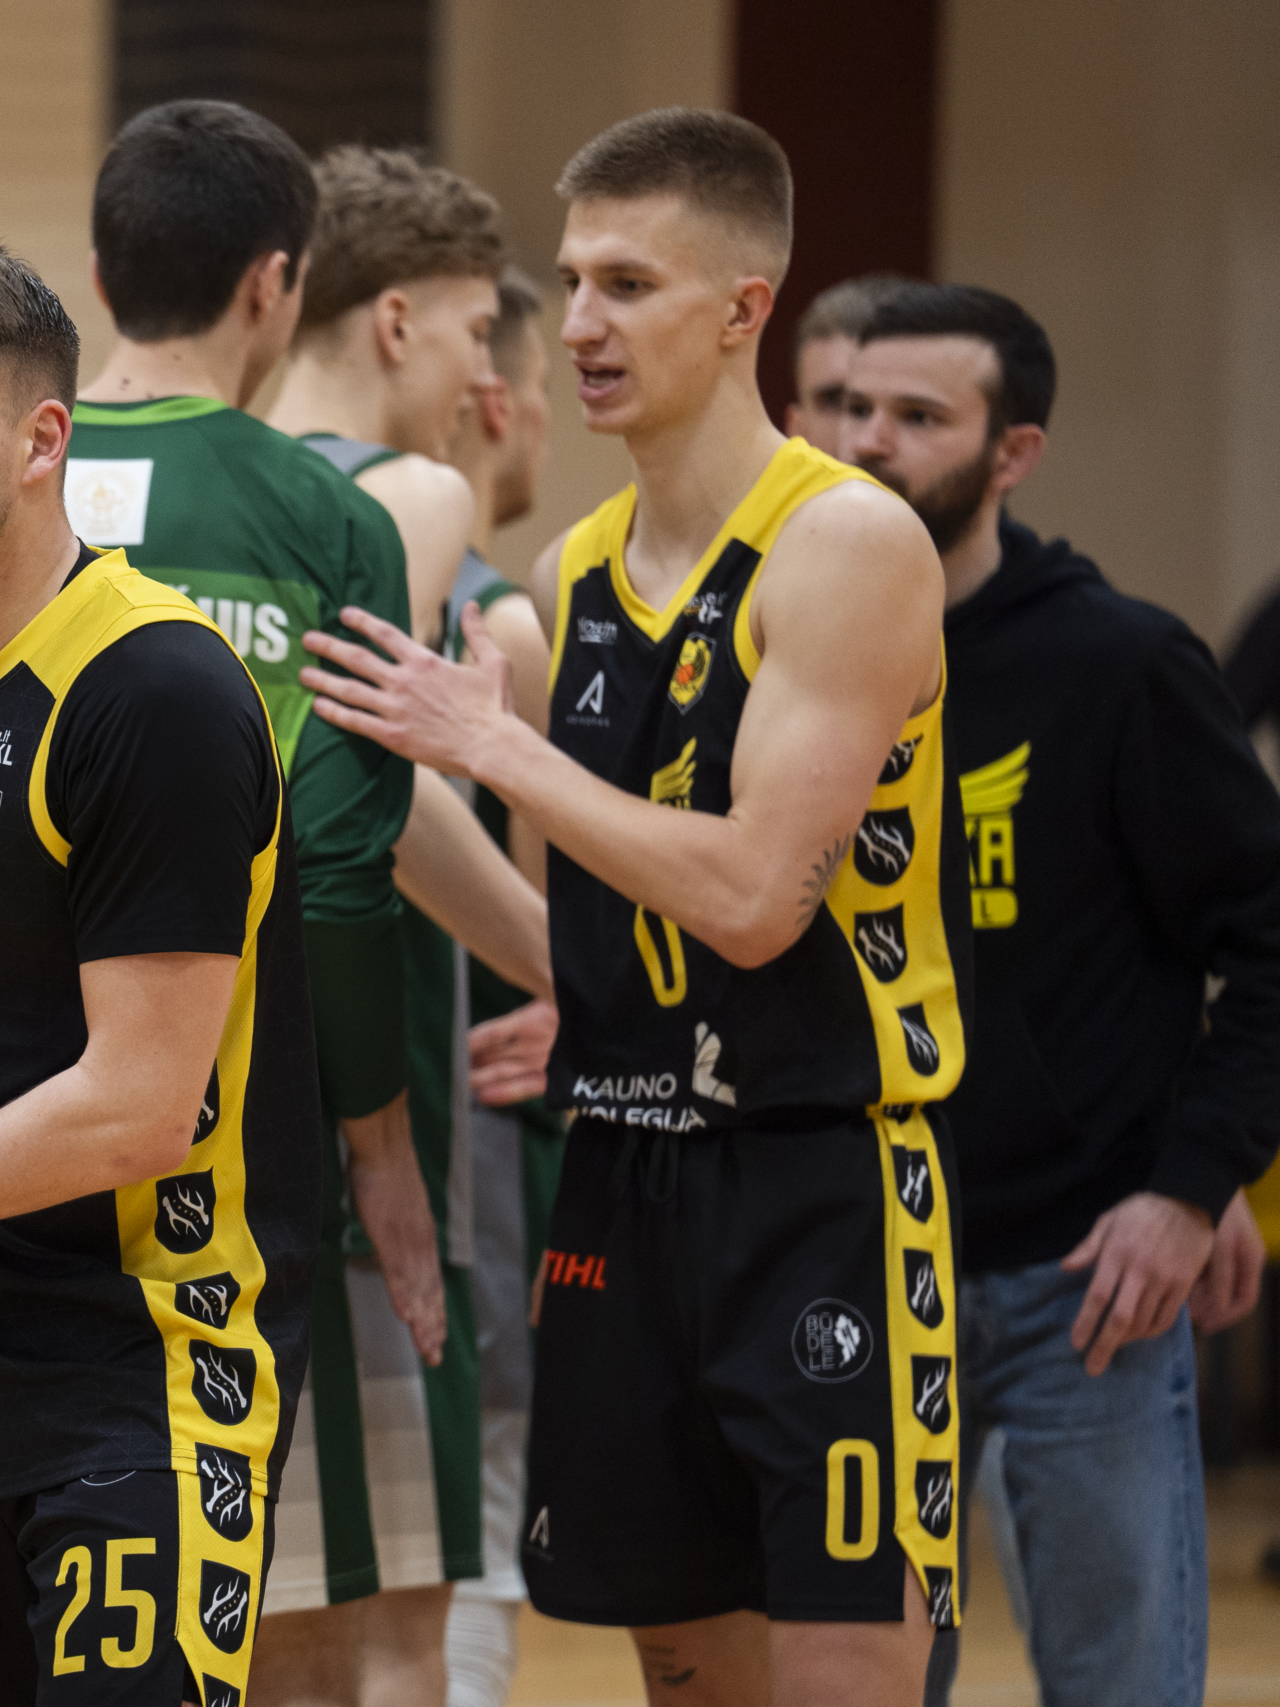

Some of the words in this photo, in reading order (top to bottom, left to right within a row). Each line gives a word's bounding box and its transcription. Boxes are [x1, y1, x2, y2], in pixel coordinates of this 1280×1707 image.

[572, 1072, 678, 1102] KAUNO
[825, 1438, 880, 1561] 0
[52, 1537, 157, 1677] 25
